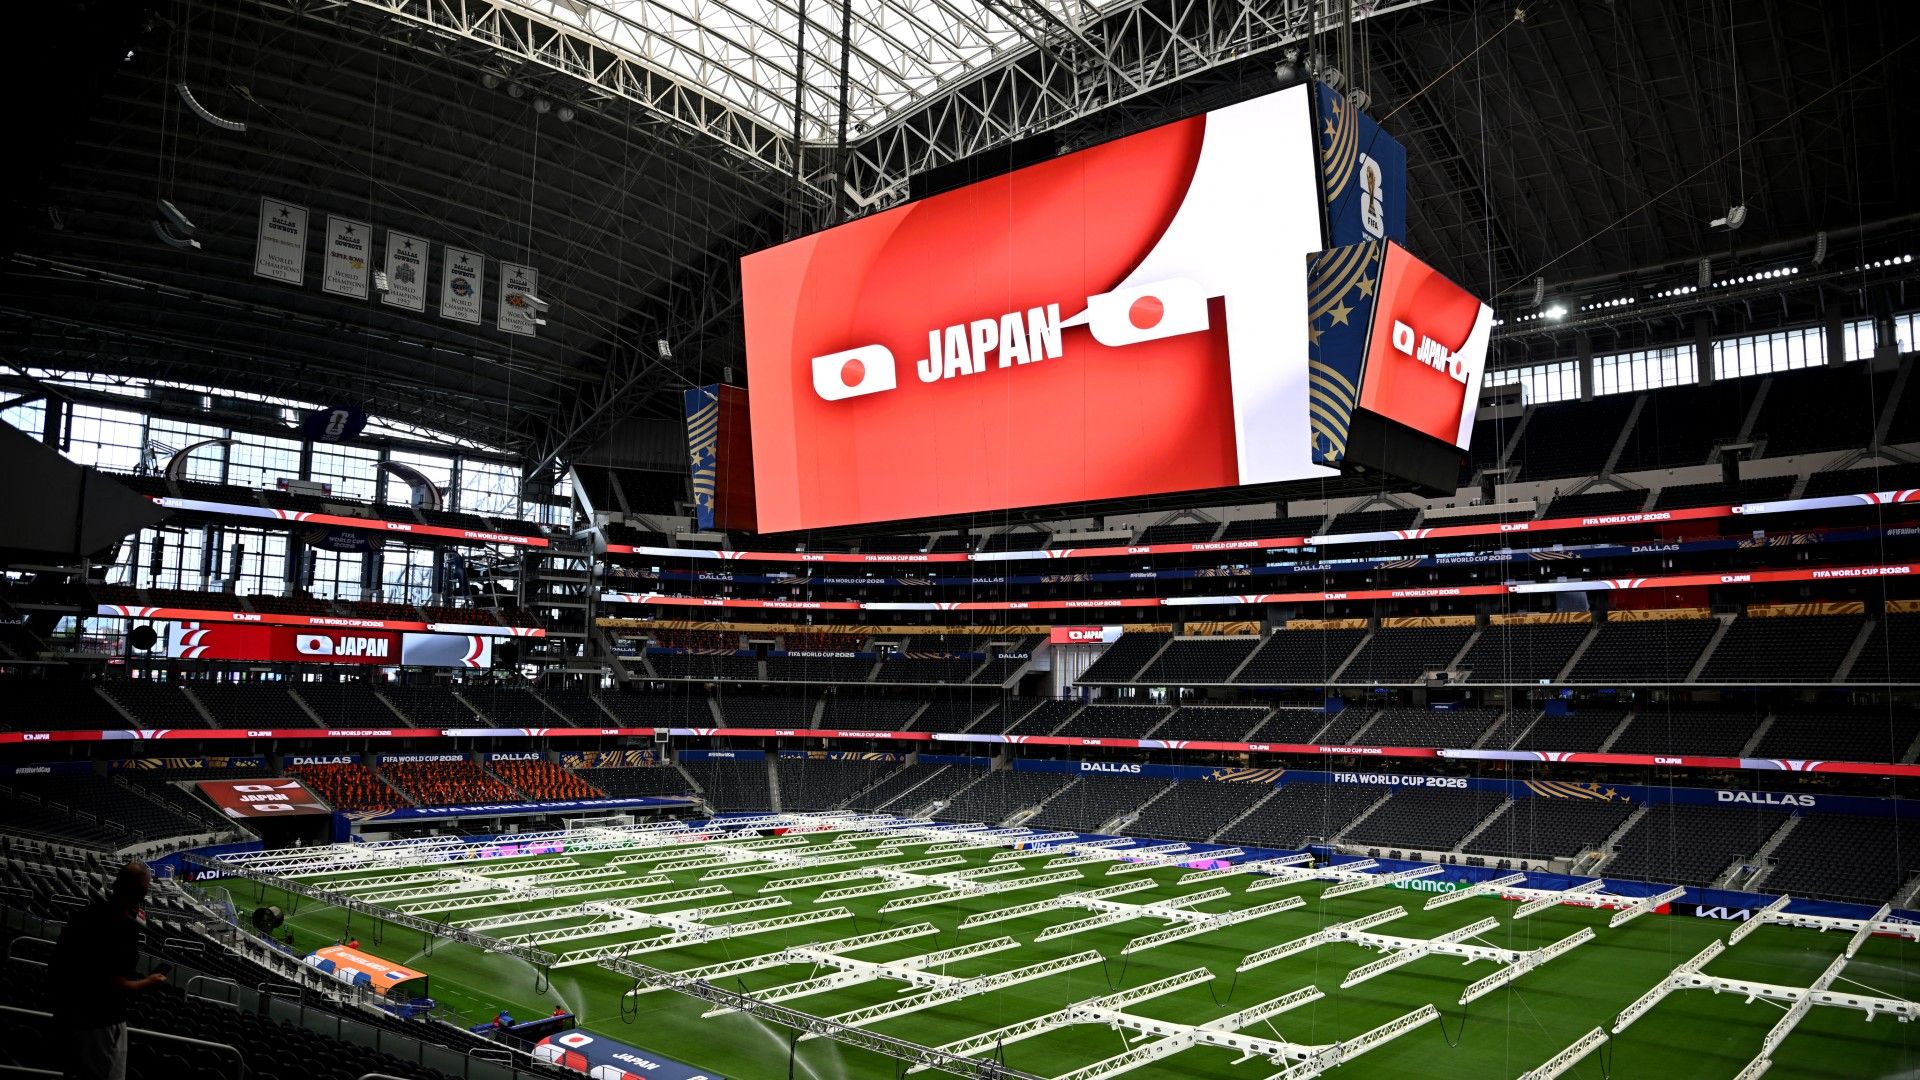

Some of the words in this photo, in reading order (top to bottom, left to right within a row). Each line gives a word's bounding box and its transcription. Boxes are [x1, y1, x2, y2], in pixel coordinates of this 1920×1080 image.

[269, 222, 298, 234] COWBOYS
[272, 217, 296, 228] DALLAS
[1368, 216, 1378, 230] FIFA
[338, 234, 360, 244] DALLAS
[335, 240, 362, 250] COWBOYS
[397, 248, 418, 258] DALLAS
[268, 254, 293, 265] WORLD
[394, 254, 420, 264] COWBOYS
[260, 260, 300, 273] CHAMPIONS
[454, 264, 474, 272] DALLAS
[336, 270, 358, 280] WORLD
[452, 268, 476, 278] COWBOYS
[328, 275, 366, 288] CHAMPIONS
[510, 278, 528, 286] DALLAS
[394, 283, 416, 294] WORLD
[507, 284, 530, 292] COWBOYS
[386, 288, 422, 302] HAMPIONS
[452, 298, 472, 307] WORLD
[444, 303, 478, 315] CHAMPIONS
[502, 317, 530, 328] CHAMPION
[917, 303, 1063, 383] JAPAN
[1416, 335, 1448, 373] JAPAN
[1582, 518, 1599, 526] FIFA
[1599, 516, 1626, 524] WORLD
[1642, 512, 1670, 521] 2026
[478, 532, 498, 540] WORLD
[498, 534, 509, 542] CUP
[1632, 544, 1680, 553] DALLAS
[1451, 556, 1474, 564] WORLD
[1294, 564, 1331, 572] DALLAS
[1813, 570, 1830, 578] FIFA
[1830, 569, 1860, 578] WORLD
[1861, 568, 1878, 576] CUP
[1879, 566, 1910, 574] 2026
[324, 618, 348, 626] WORLD
[336, 636, 388, 657] JAPAN
[293, 756, 352, 765] DALLAS
[440, 754, 463, 762] 2026
[492, 753, 539, 761] DALLAS
[1081, 762, 1141, 773] DALLAS
[1334, 773, 1358, 784] FIFA
[1360, 774, 1400, 785] WORLD
[1402, 776, 1424, 786] CUP
[1426, 777, 1468, 788] 2026
[240, 794, 290, 802] JAPAN
[1718, 790, 1816, 807] DALLAS
[196, 870, 220, 880] ADI
[1394, 878, 1456, 893] aramco
[1696, 905, 1750, 921] KIA
[612, 1053, 660, 1070] JAPAN
